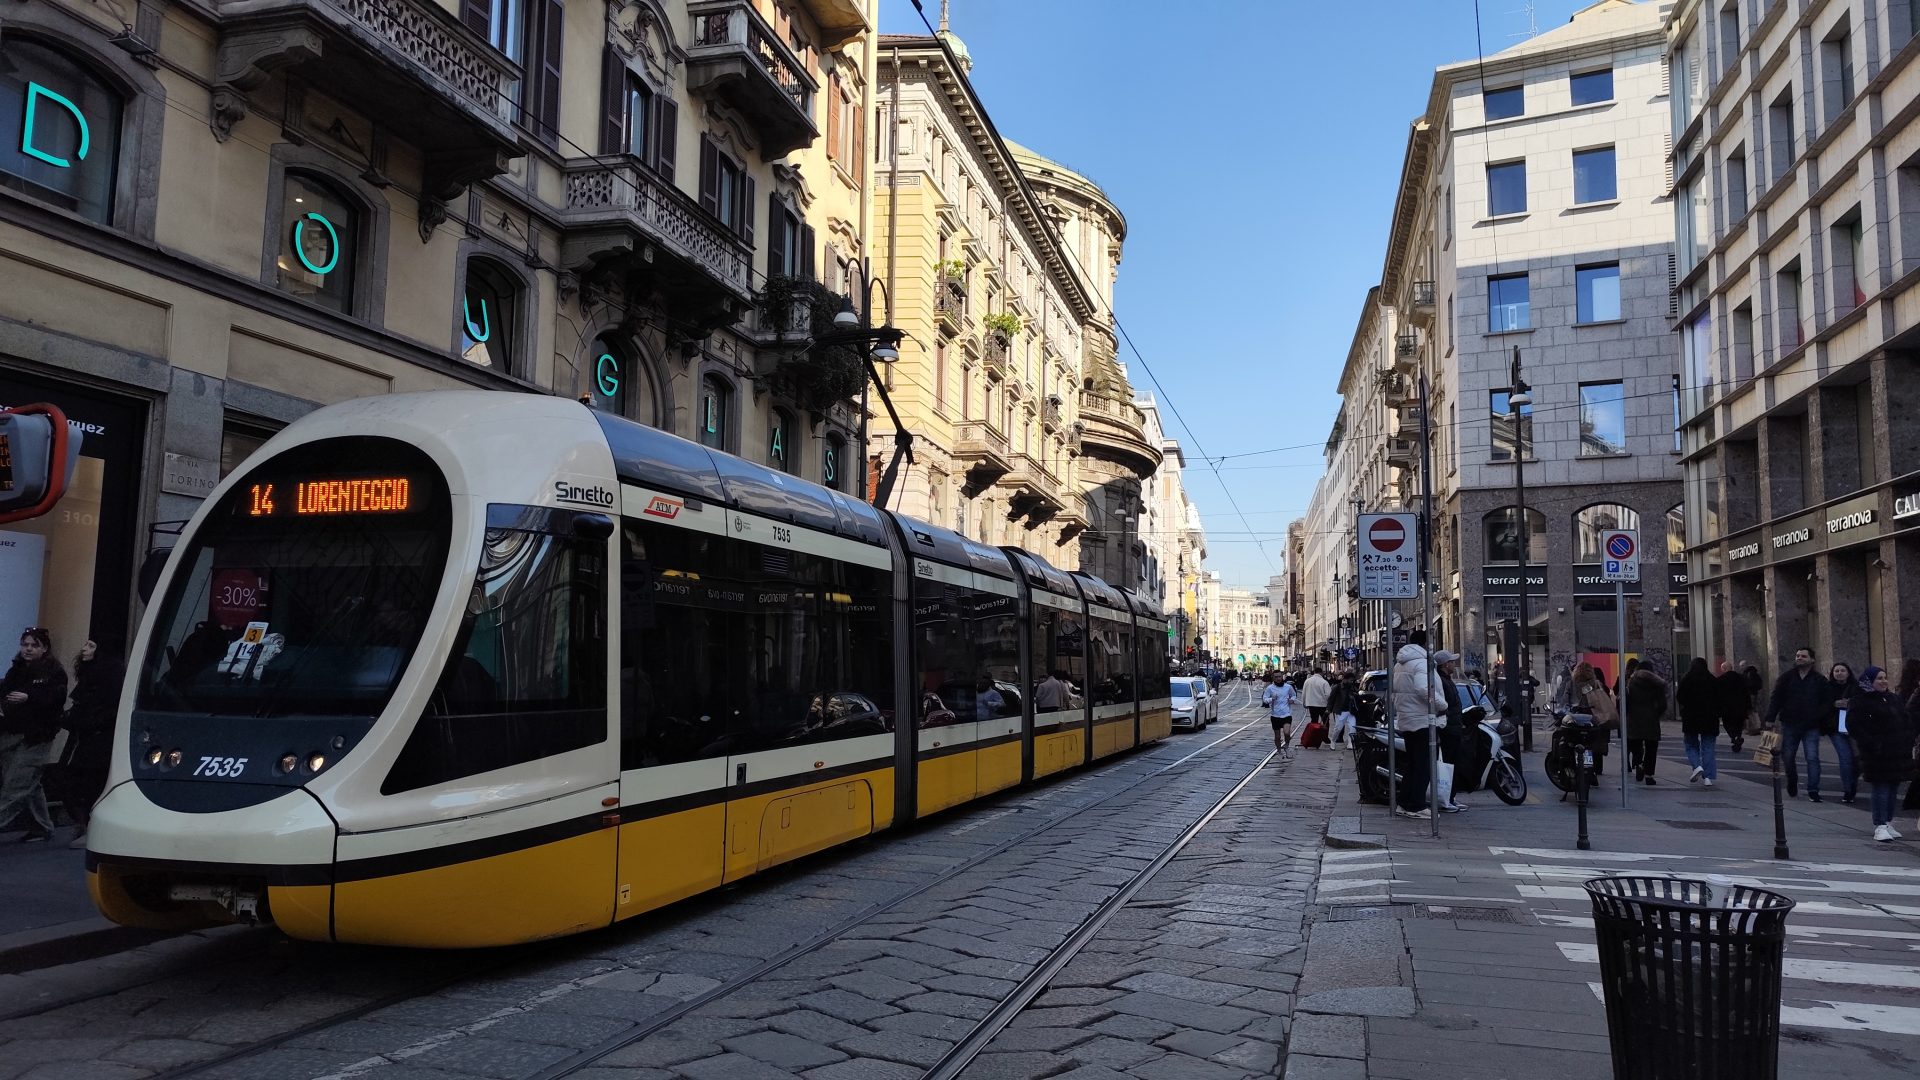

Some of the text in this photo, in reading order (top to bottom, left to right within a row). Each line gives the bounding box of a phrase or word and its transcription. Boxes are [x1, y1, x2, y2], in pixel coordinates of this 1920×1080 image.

[169, 473, 215, 489] TORINO
[250, 478, 408, 515] 14 LORENTEGGIO
[555, 481, 614, 505] Sirietto
[655, 502, 672, 514] ATM
[1895, 491, 1920, 515] CAL
[772, 525, 791, 543] 7535
[1396, 554, 1413, 563] 9.00
[1609, 562, 1617, 571] P
[248, 630, 258, 641] 3
[241, 645, 256, 655] 14
[192, 756, 249, 778] 7535
